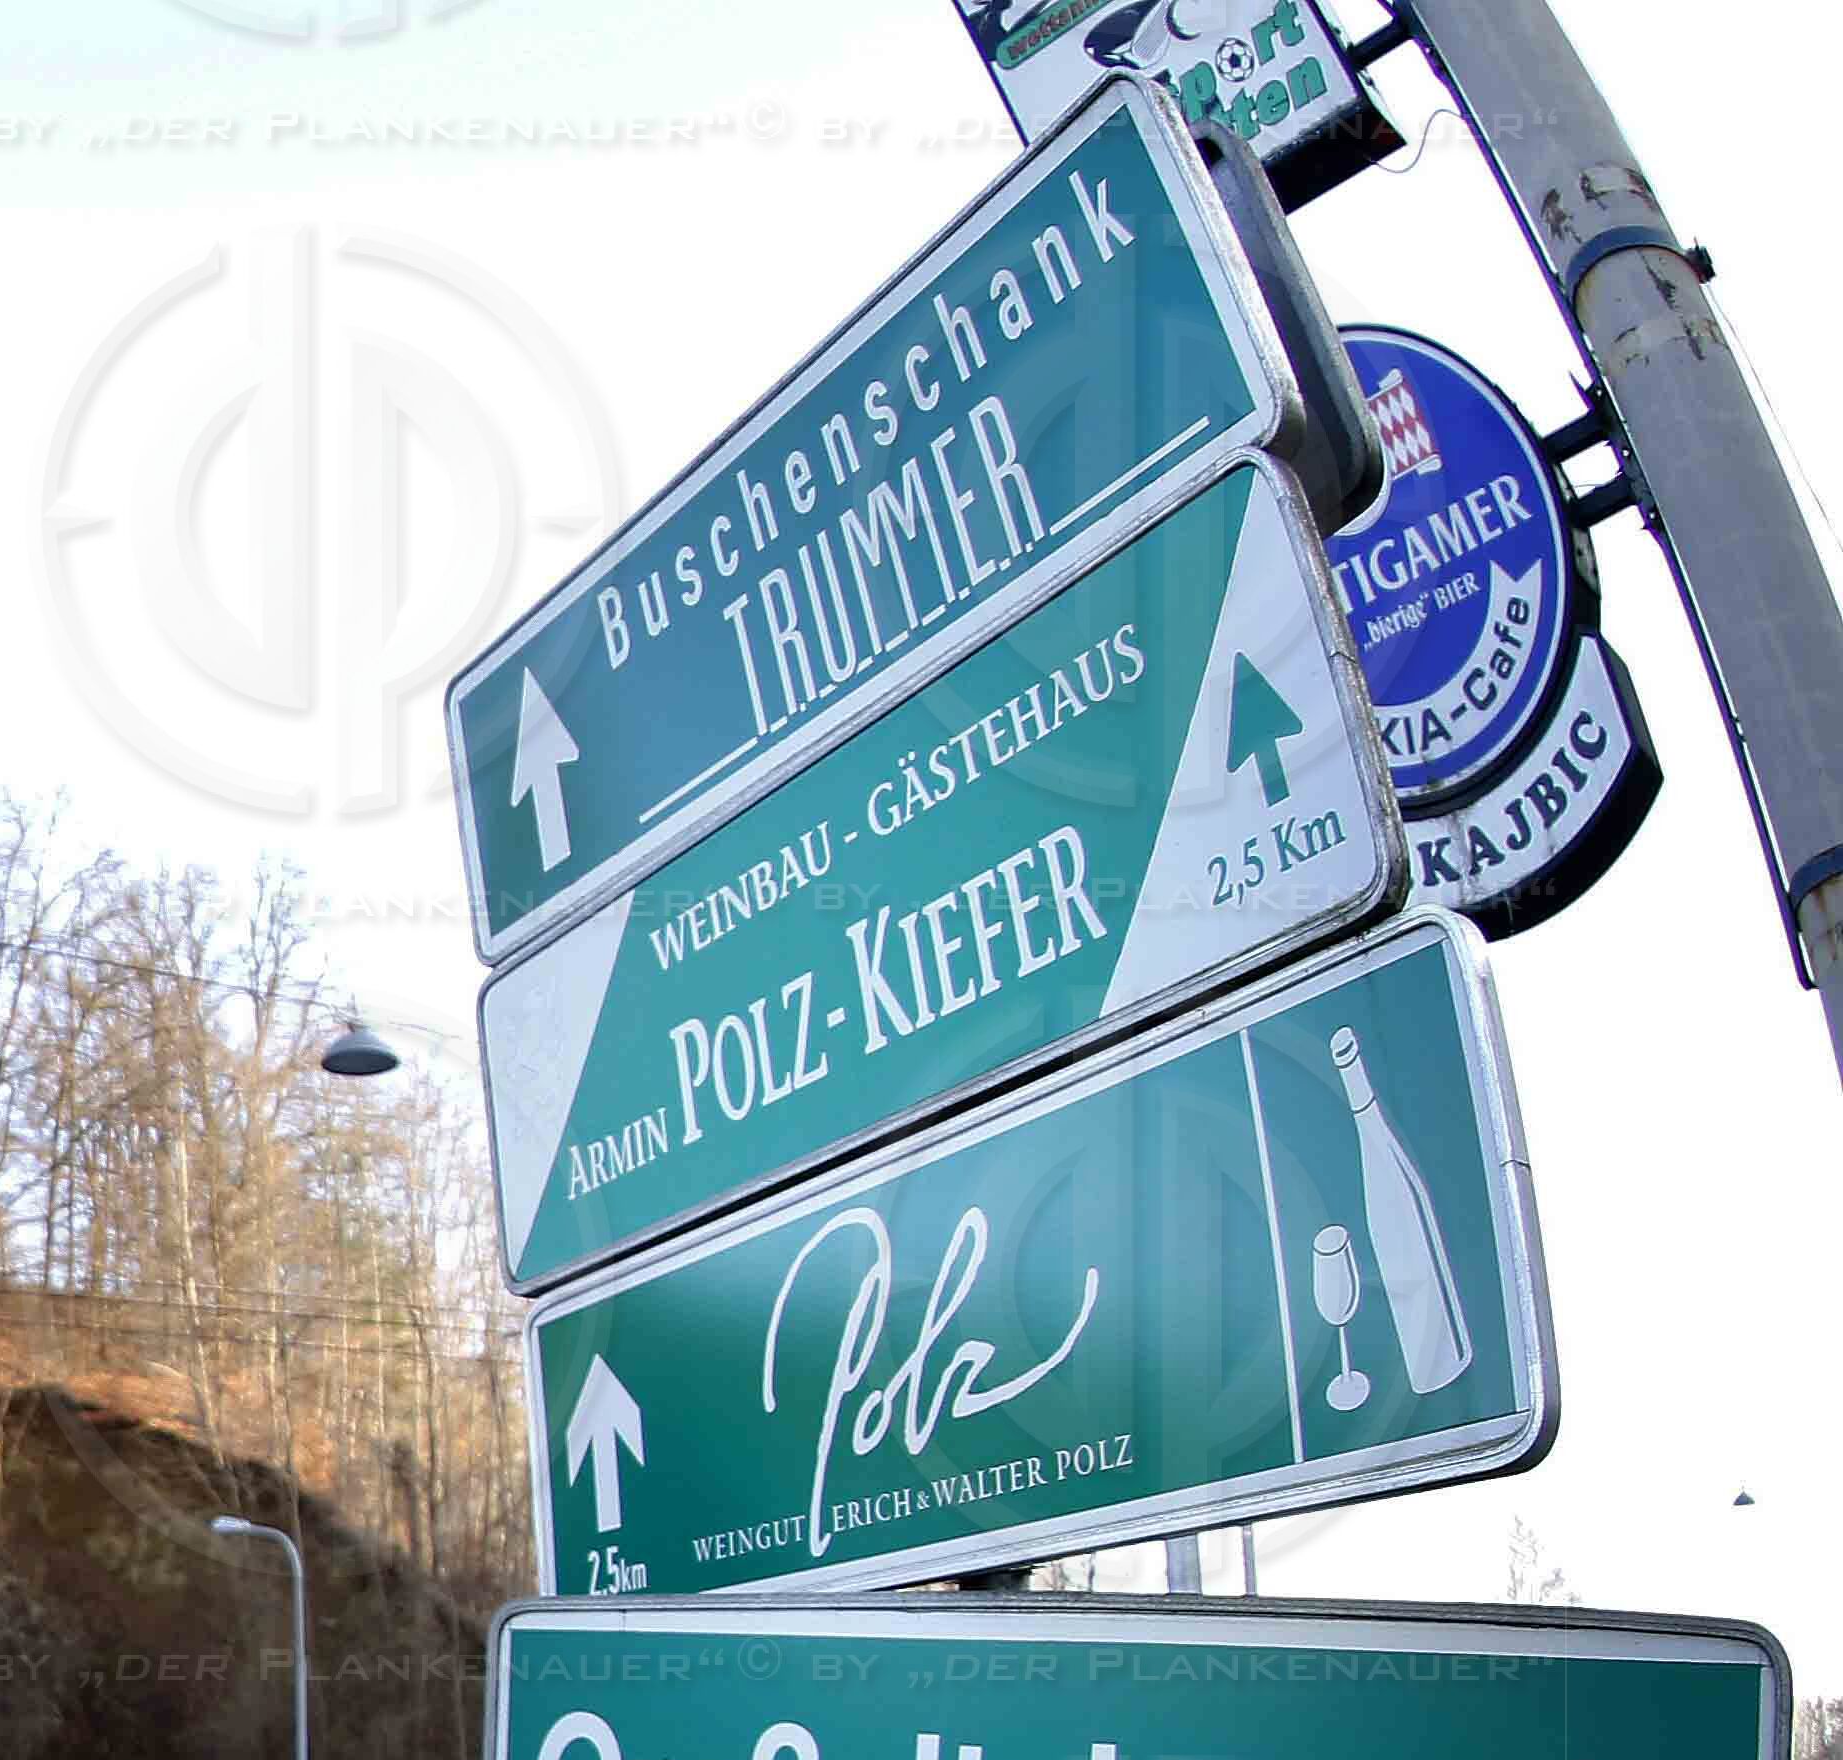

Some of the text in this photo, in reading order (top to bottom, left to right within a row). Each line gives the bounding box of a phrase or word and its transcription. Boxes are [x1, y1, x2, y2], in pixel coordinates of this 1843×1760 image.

[597, 170, 1137, 671] Buschenschank
[723, 396, 1046, 737] TRUMMER
[1434, 571, 1481, 612] BIER
[649, 823, 835, 970] WEINBAU
[865, 622, 1148, 838] GÄSTEHAUS
[1206, 804, 1347, 908] 2,5 Km
[1416, 710, 1608, 888] KAJBIC
[568, 1108, 670, 1200] ARMIN
[692, 1515, 806, 1562] WEINGUT
[931, 1456, 1047, 1508] WALTER
[1054, 1434, 1133, 1481] POLZ
